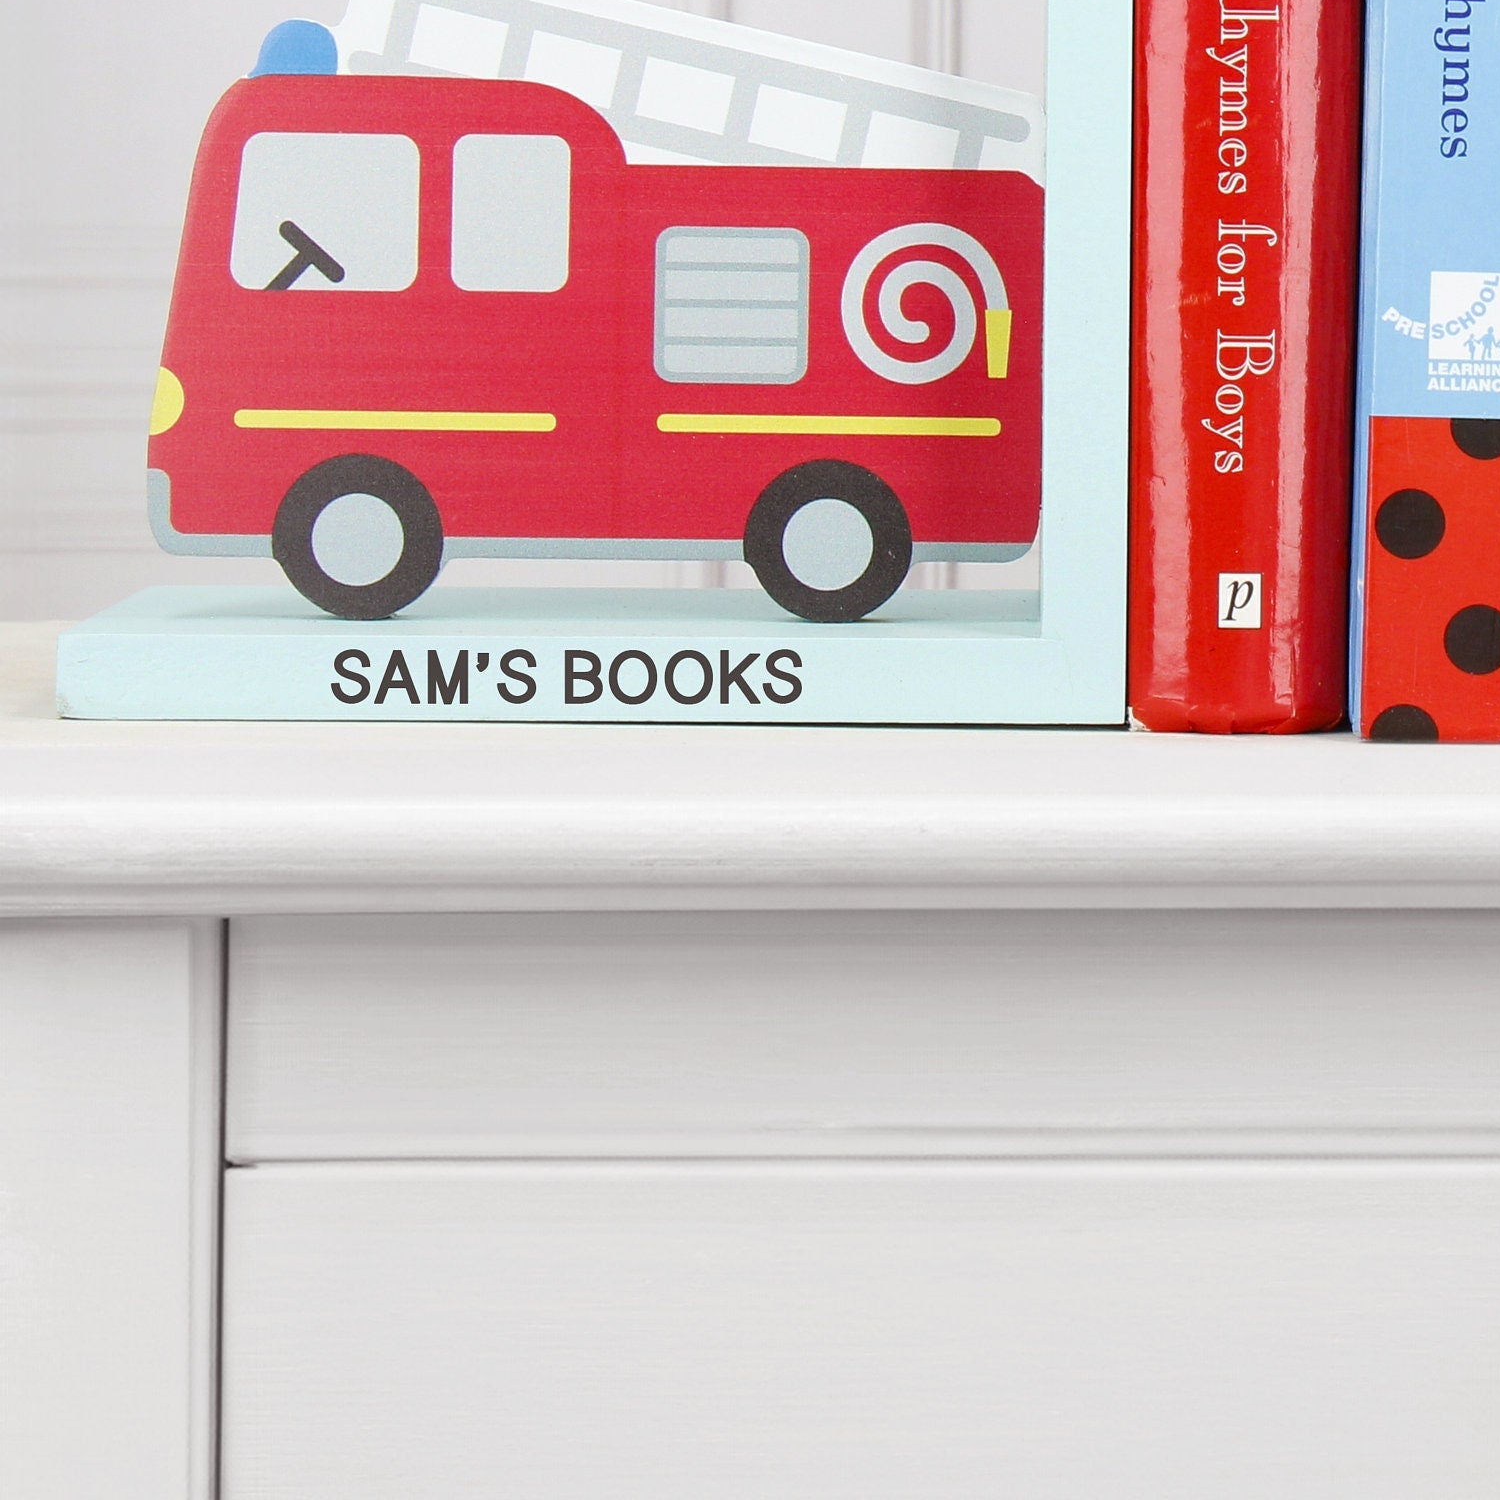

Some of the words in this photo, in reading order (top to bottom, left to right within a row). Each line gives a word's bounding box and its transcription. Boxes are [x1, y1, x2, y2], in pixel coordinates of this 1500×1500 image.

[1216, 217, 1278, 307] for
[1380, 306, 1427, 340] PRE
[1430, 275, 1500, 340] SCHOOL
[1201, 328, 1276, 474] Boys
[330, 648, 538, 705] SAM'S
[564, 648, 803, 705] BOOKS
